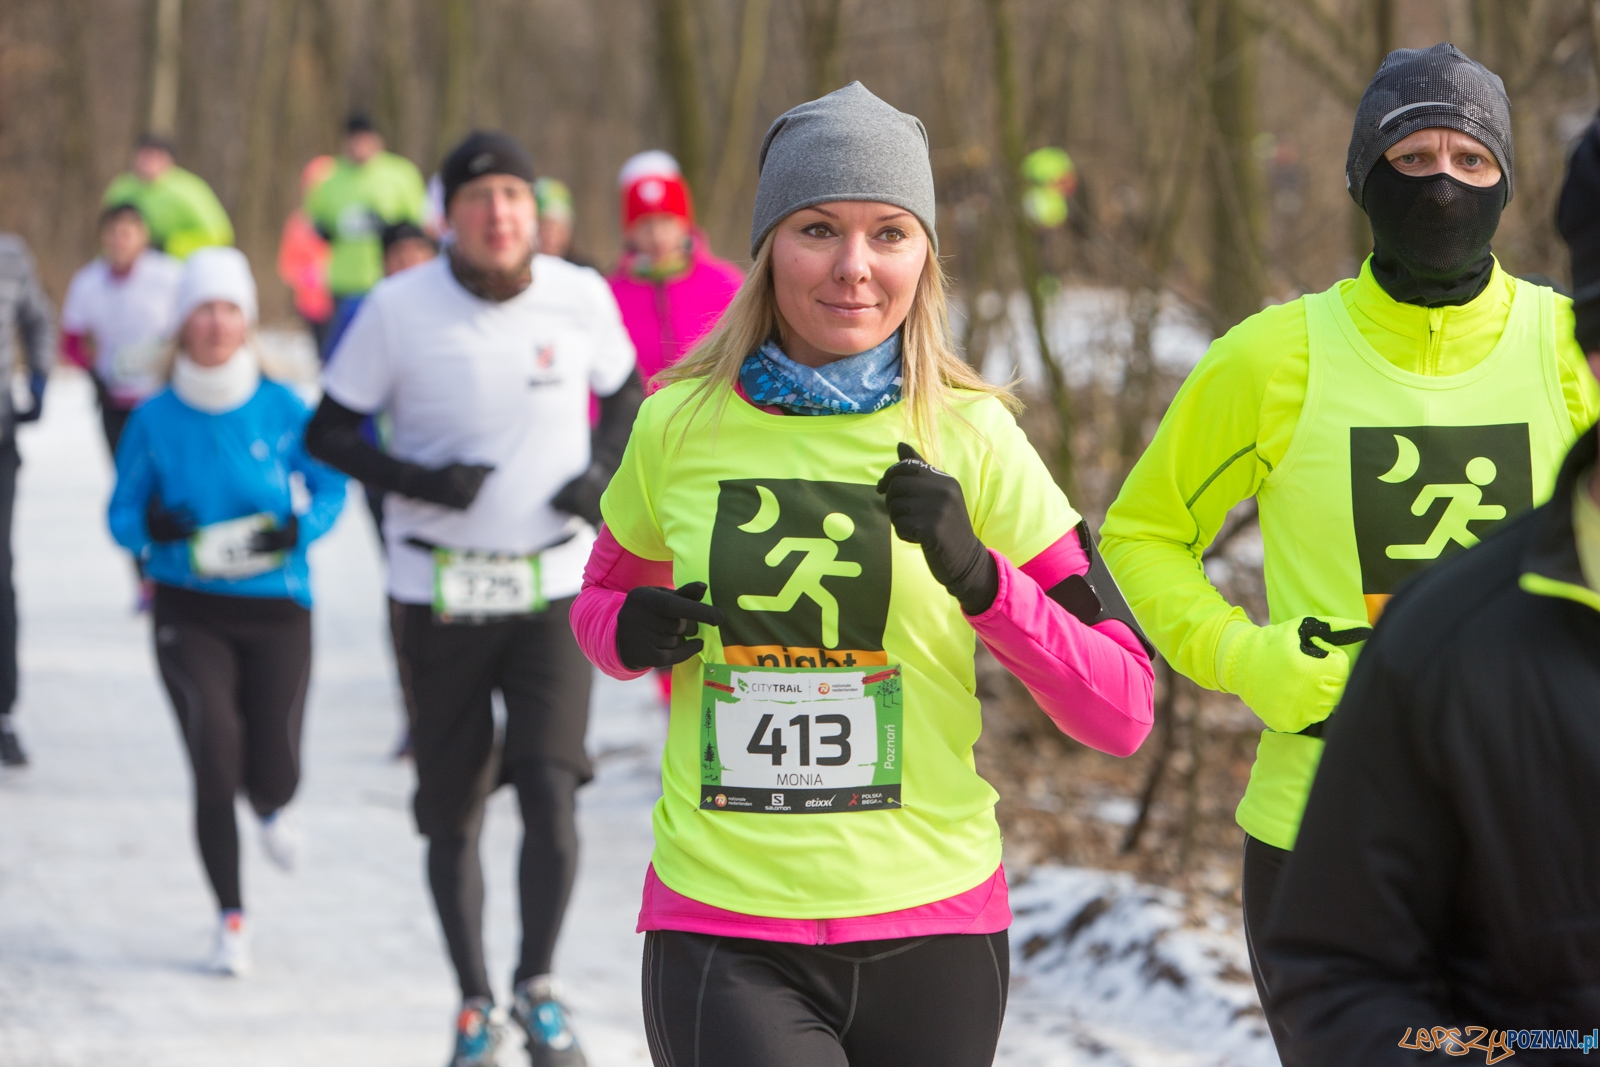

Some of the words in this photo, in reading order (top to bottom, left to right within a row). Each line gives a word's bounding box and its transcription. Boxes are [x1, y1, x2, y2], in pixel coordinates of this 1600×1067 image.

[746, 713, 852, 767] 413
[883, 724, 896, 770] Poznań
[776, 773, 823, 786] MONIA
